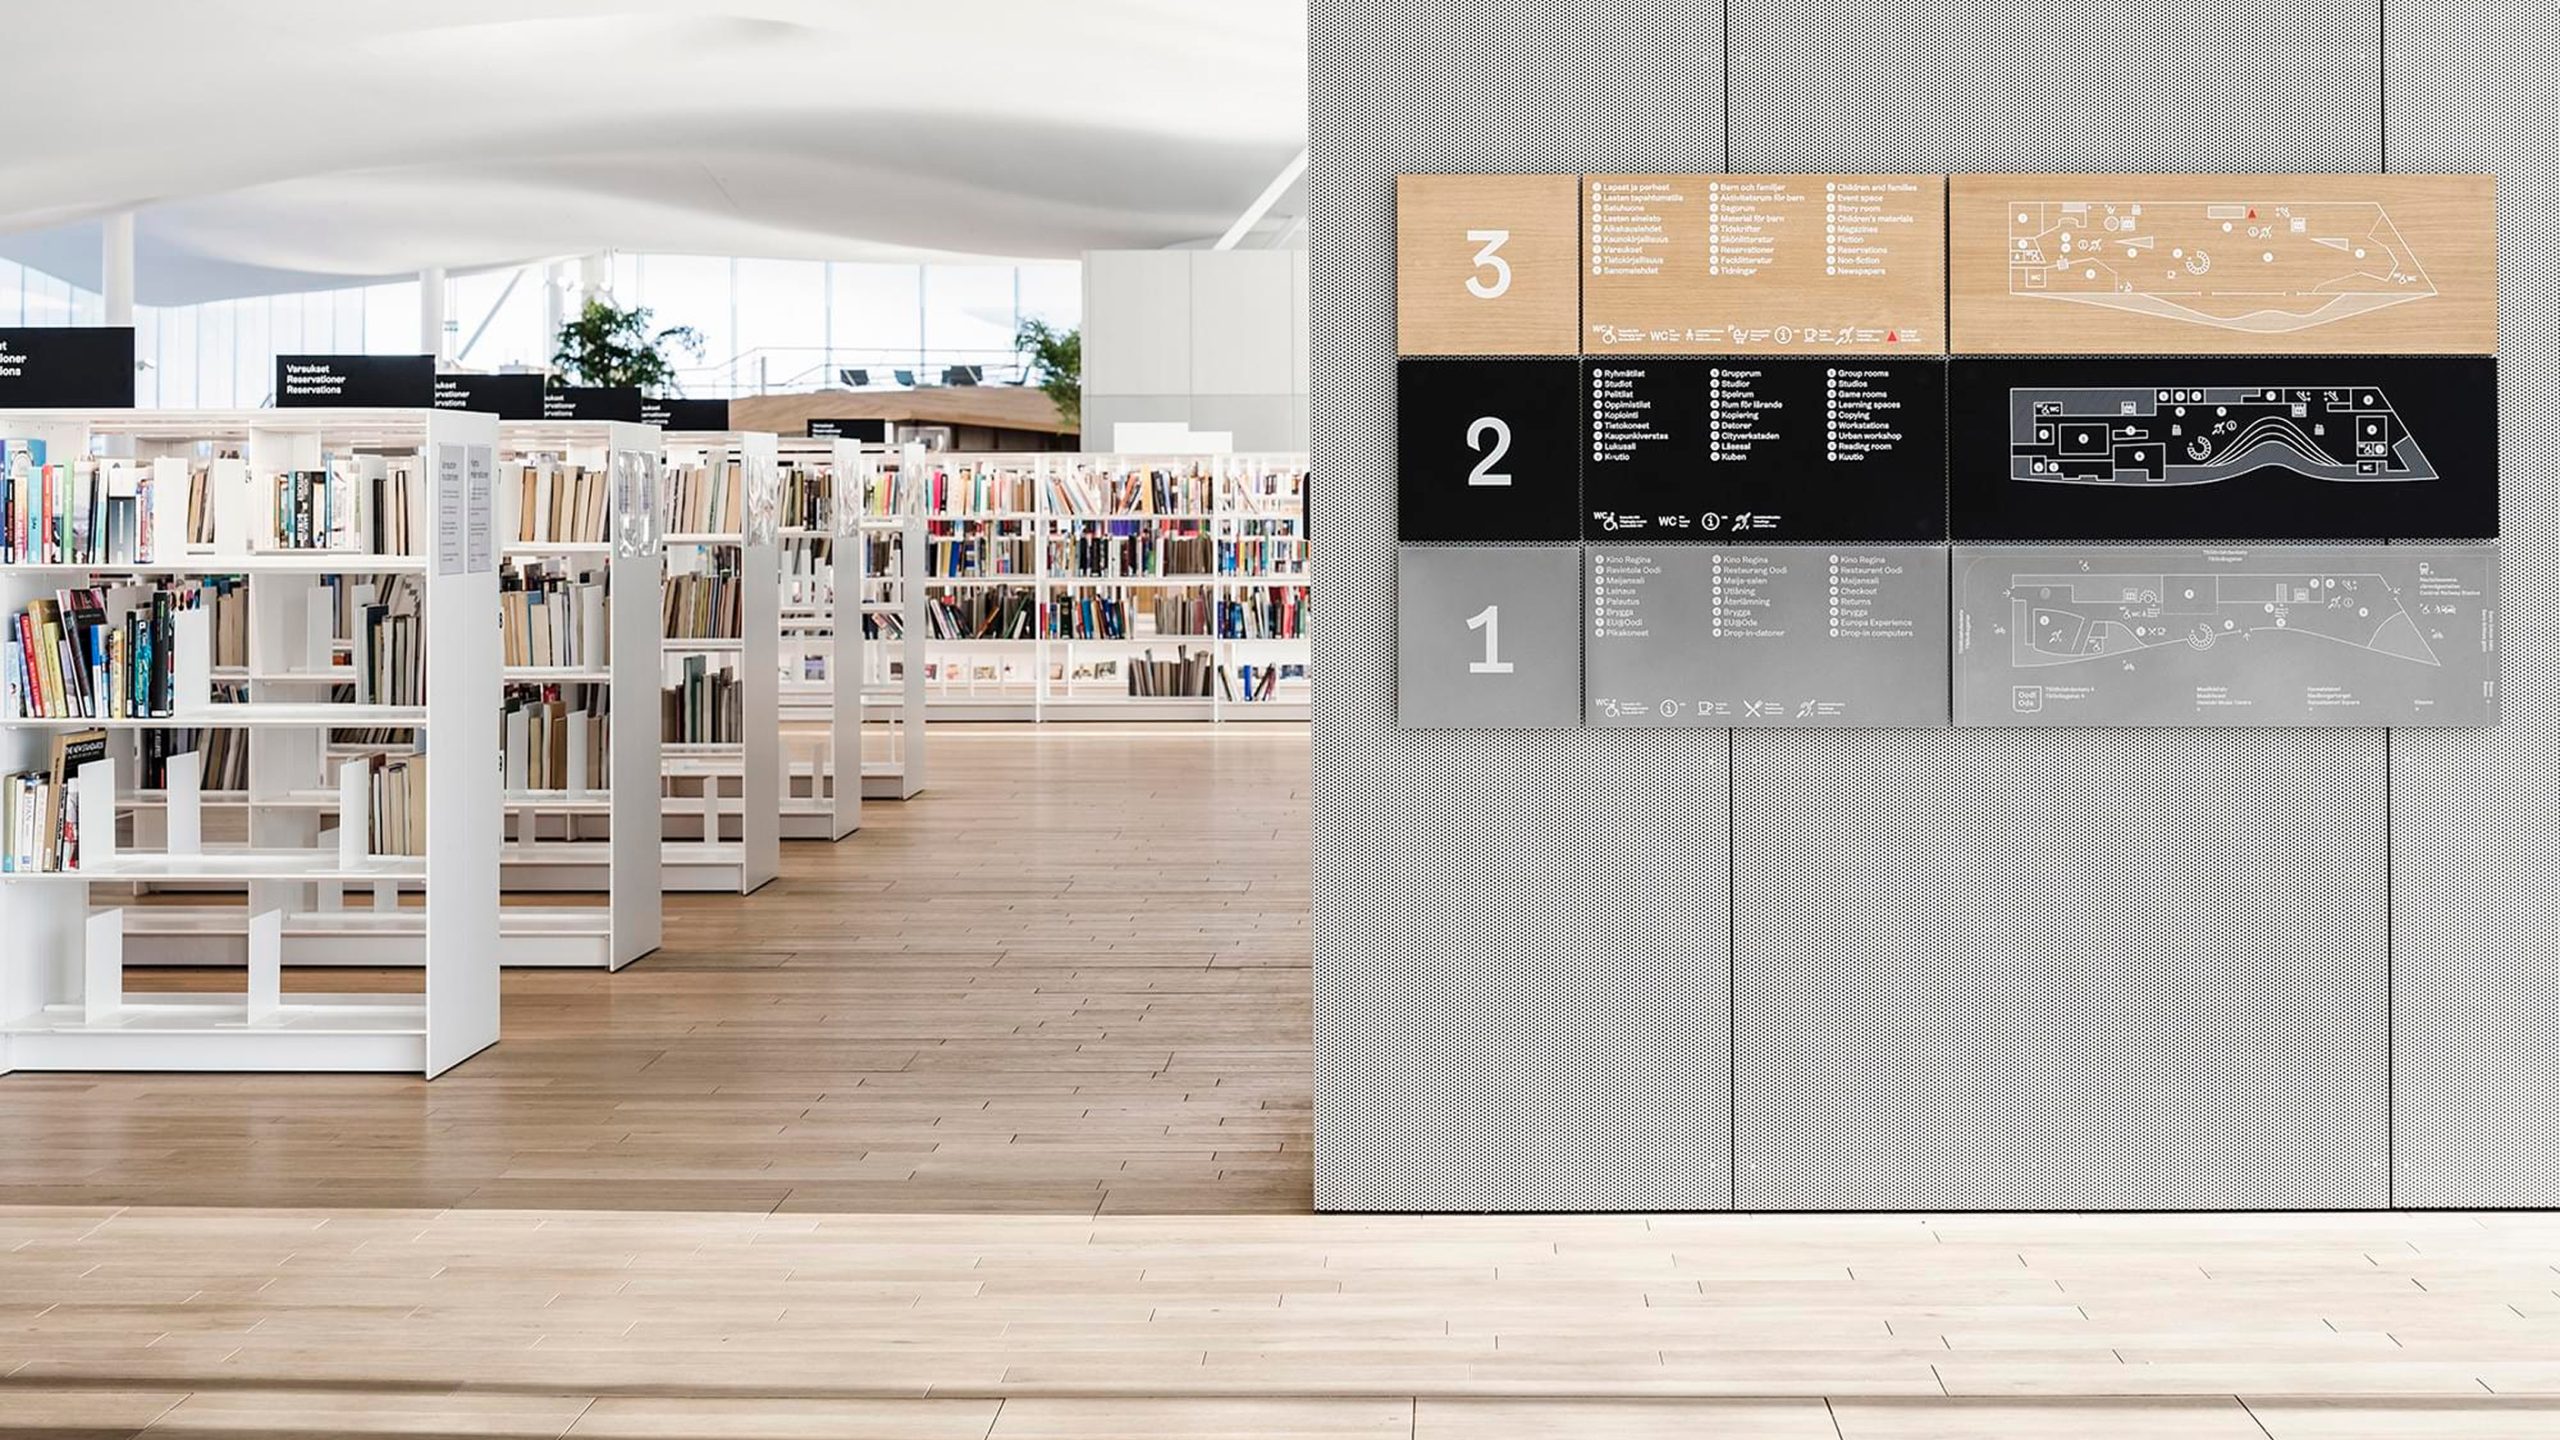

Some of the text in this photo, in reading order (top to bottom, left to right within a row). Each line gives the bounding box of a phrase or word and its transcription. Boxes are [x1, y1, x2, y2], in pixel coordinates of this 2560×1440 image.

[1465, 230, 1512, 299] 3
[1650, 331, 1669, 341] WC
[286, 364, 330, 374] Varaukset
[1604, 370, 1645, 379] Ryhmätilat
[1721, 370, 1762, 379] Grupprum
[1838, 370, 1863, 379] Group
[286, 375, 346, 384] Reservationer
[286, 386, 342, 394] Reservations
[1721, 390, 1754, 400] Spelrum
[1604, 401, 1651, 410] Oppimistilat
[1838, 401, 1872, 410] Learning
[1604, 411, 1639, 420] Kopiointi
[1721, 411, 1760, 420] Kopiering
[1838, 411, 1870, 420] Copying
[1864, 432, 1902, 441] workshop
[1466, 416, 1513, 487] 2
[1838, 442, 1870, 452] Reading
[1594, 512, 1608, 520] WC
[1658, 516, 1677, 526] WC
[1466, 604, 1514, 674] 1
